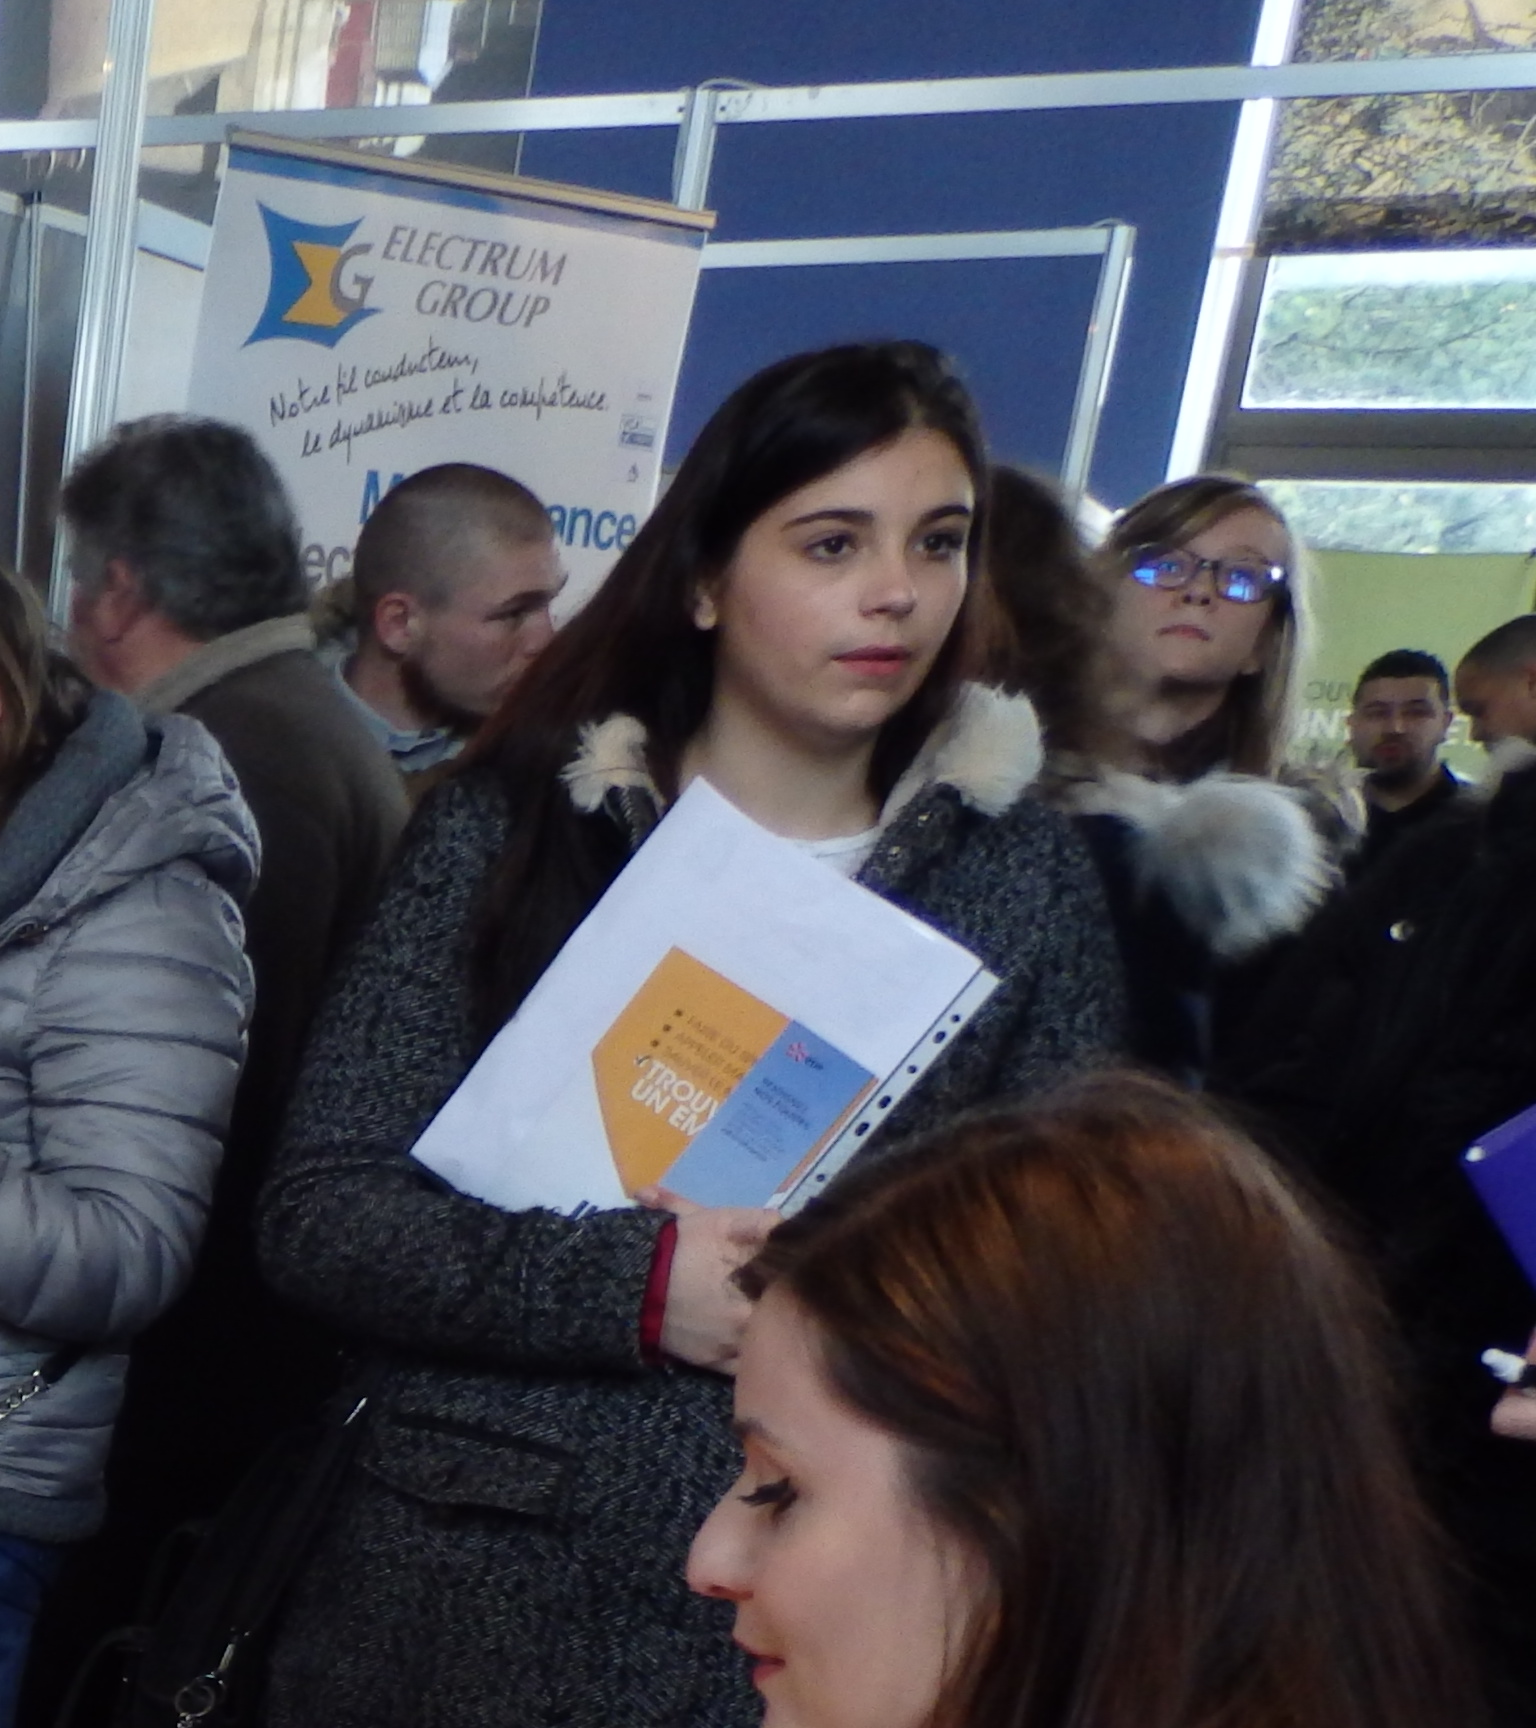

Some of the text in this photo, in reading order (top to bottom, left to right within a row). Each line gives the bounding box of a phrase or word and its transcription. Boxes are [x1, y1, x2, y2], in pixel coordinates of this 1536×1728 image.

[382, 225, 568, 287] ELECTRUM
[416, 280, 550, 329] GROUP
[270, 378, 331, 428] Notre
[337, 363, 357, 405] fil
[439, 378, 462, 415] et
[469, 384, 491, 409] la
[632, 1079, 671, 1113] UN
